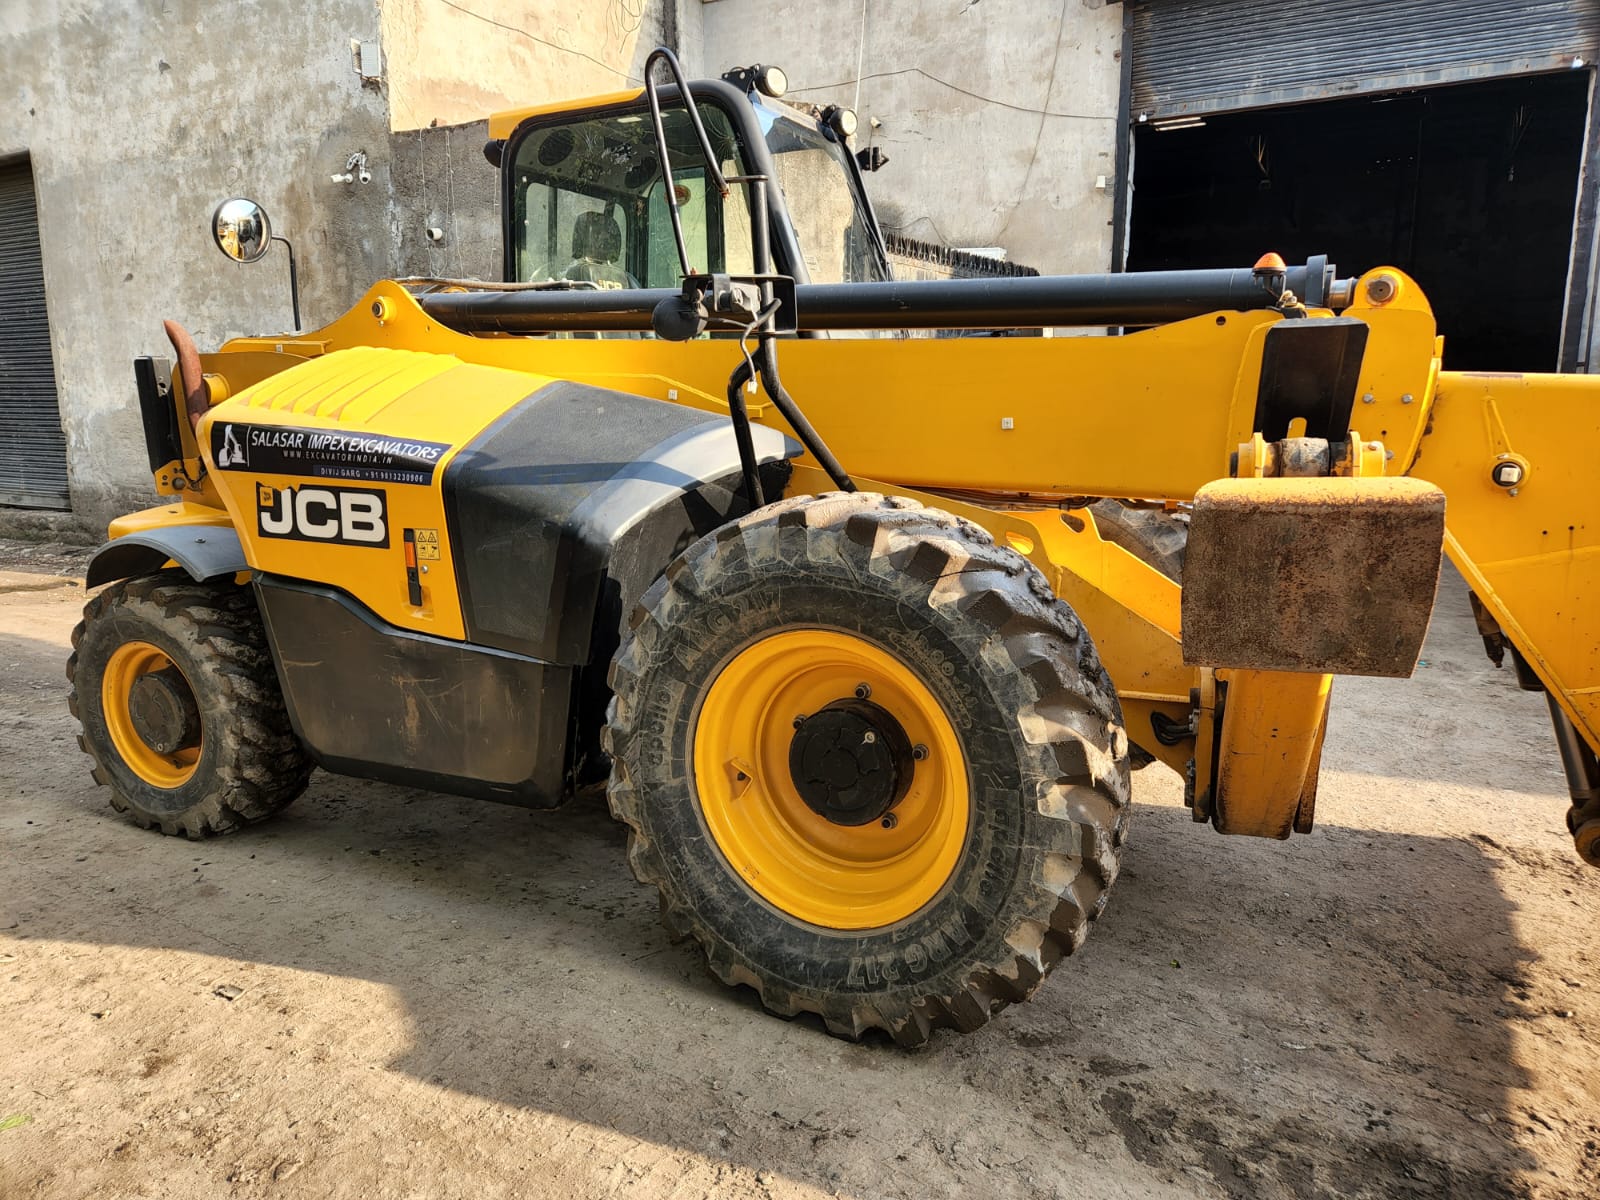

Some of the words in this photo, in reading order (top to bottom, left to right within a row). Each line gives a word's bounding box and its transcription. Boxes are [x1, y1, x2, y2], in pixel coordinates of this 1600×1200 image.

[251, 430, 305, 449] SALASAR
[307, 434, 350, 452] IMPEX
[347, 437, 442, 460] EXCAVATORS
[340, 469, 361, 478] GARG
[260, 487, 387, 543] JCB
[847, 951, 900, 986] 217
